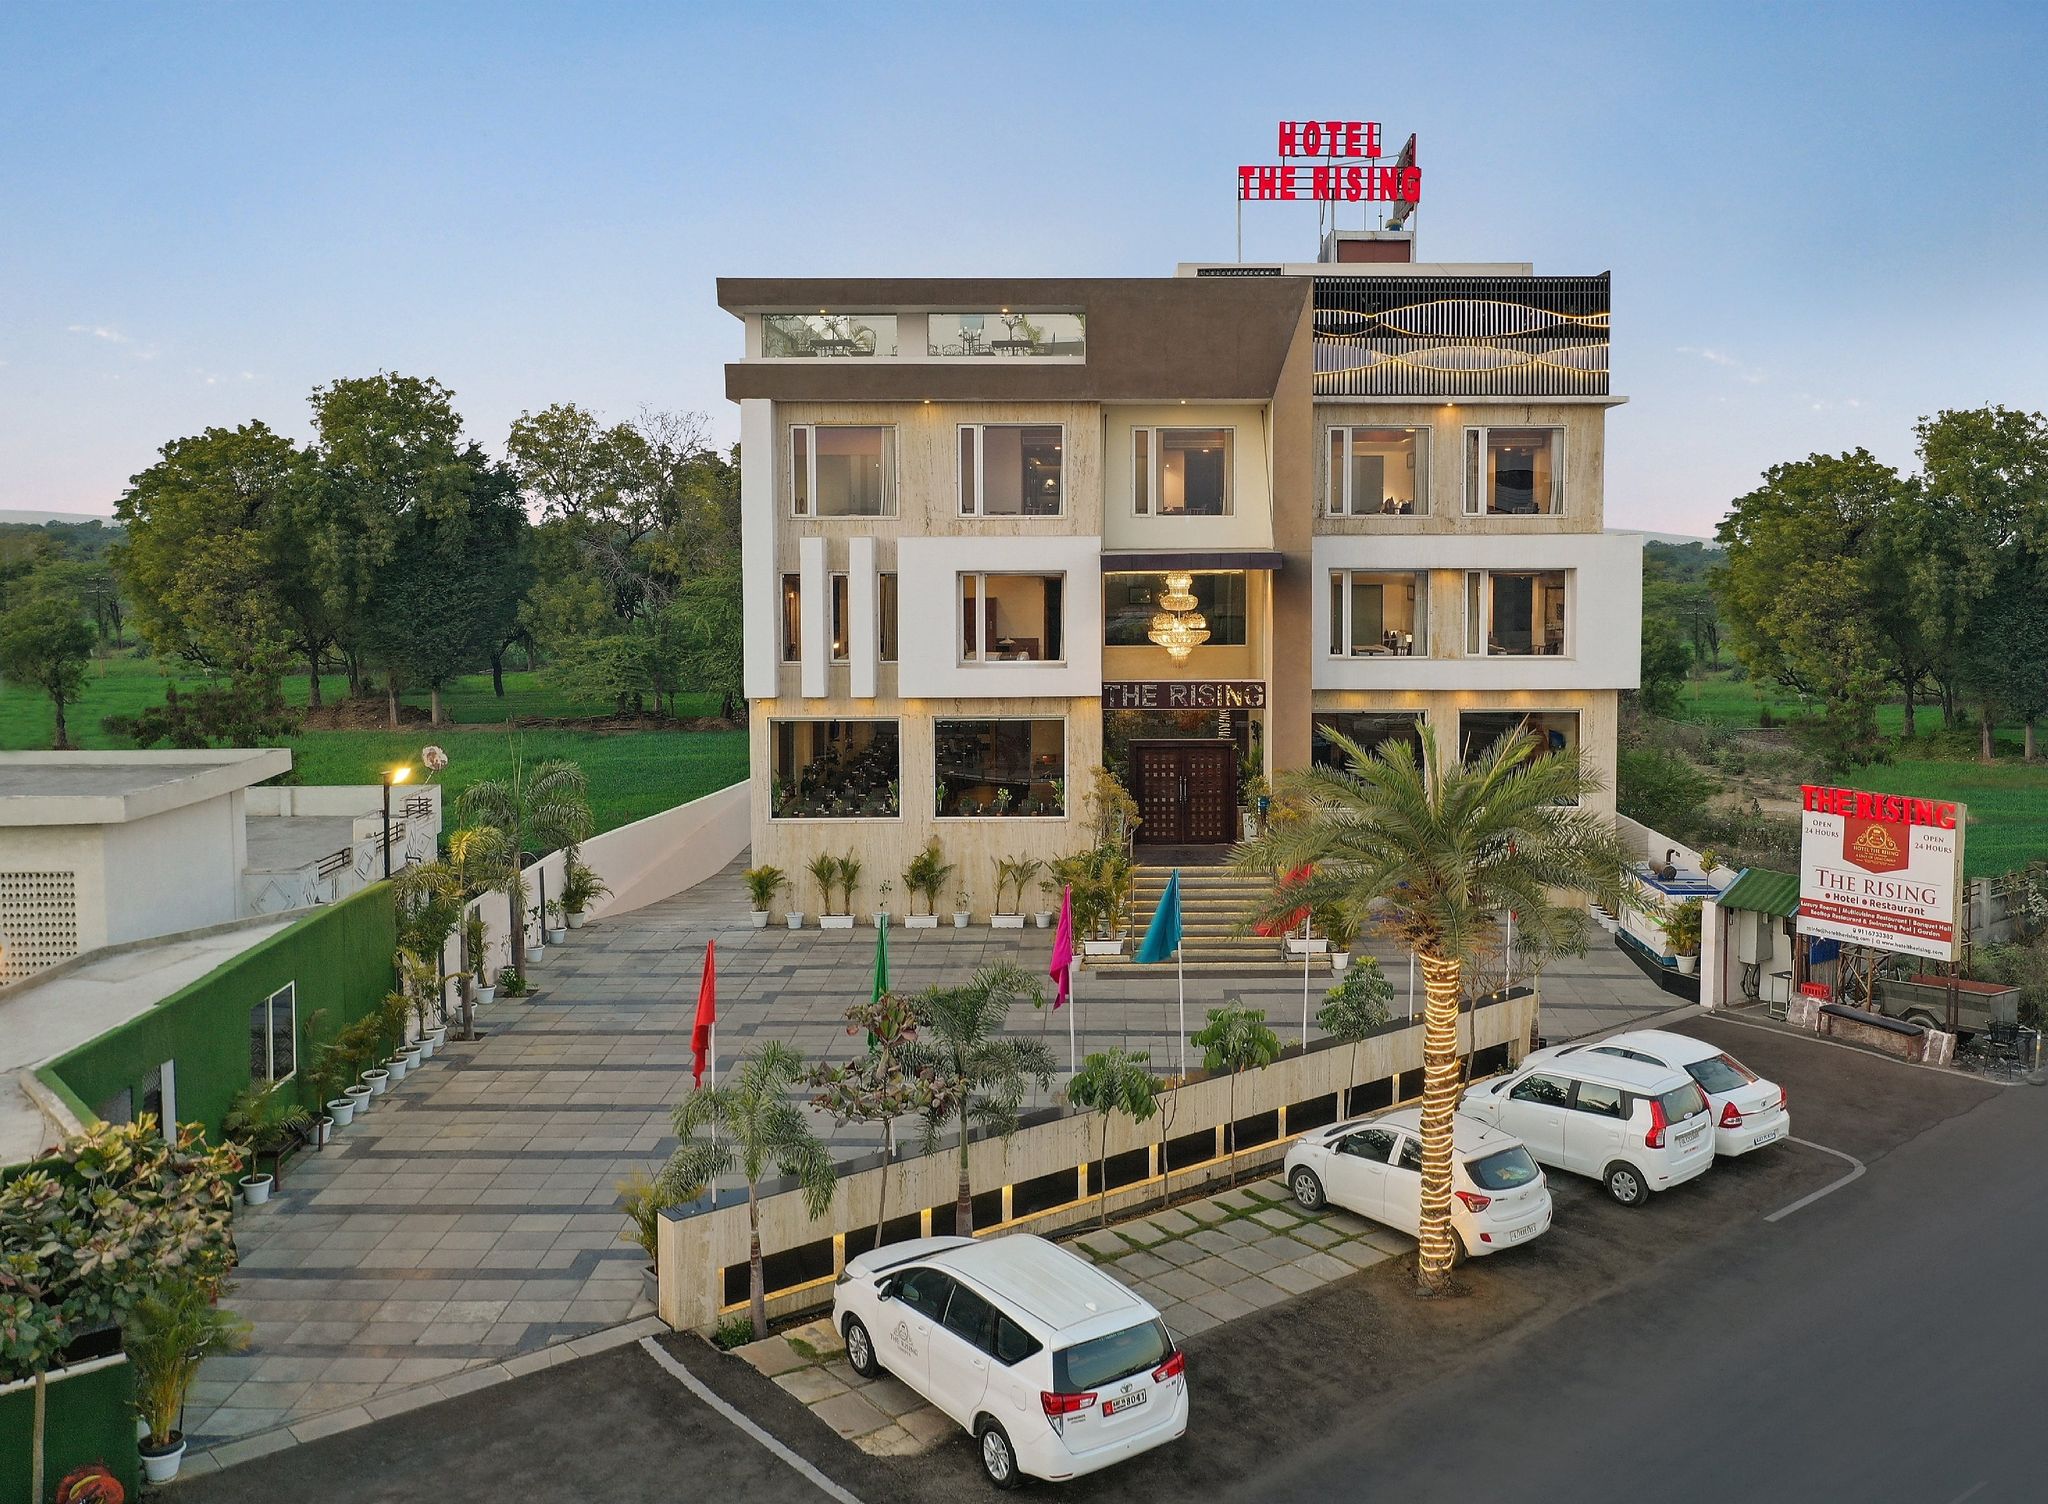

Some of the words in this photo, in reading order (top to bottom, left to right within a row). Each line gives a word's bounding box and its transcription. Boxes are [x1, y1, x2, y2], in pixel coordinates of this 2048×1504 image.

[1279, 121, 1381, 157] HOTEL
[1239, 166, 1296, 200] THE
[1313, 166, 1422, 203] RISING
[1104, 684, 1158, 707] THE
[1170, 684, 1264, 707] RISING
[1801, 784, 1854, 817] THE
[1856, 791, 1956, 830] RISING
[1812, 820, 1832, 828] OPEN
[1815, 829, 1839, 838] HOURS
[1915, 842, 1923, 850] 24
[1926, 844, 1952, 853] HOURS
[1923, 835, 1944, 843] OPEN
[1815, 869, 1856, 892] THE
[1864, 879, 1937, 905] RISING
[1833, 893, 1859, 905] Hotel
[1869, 899, 1925, 916] Restaurant
